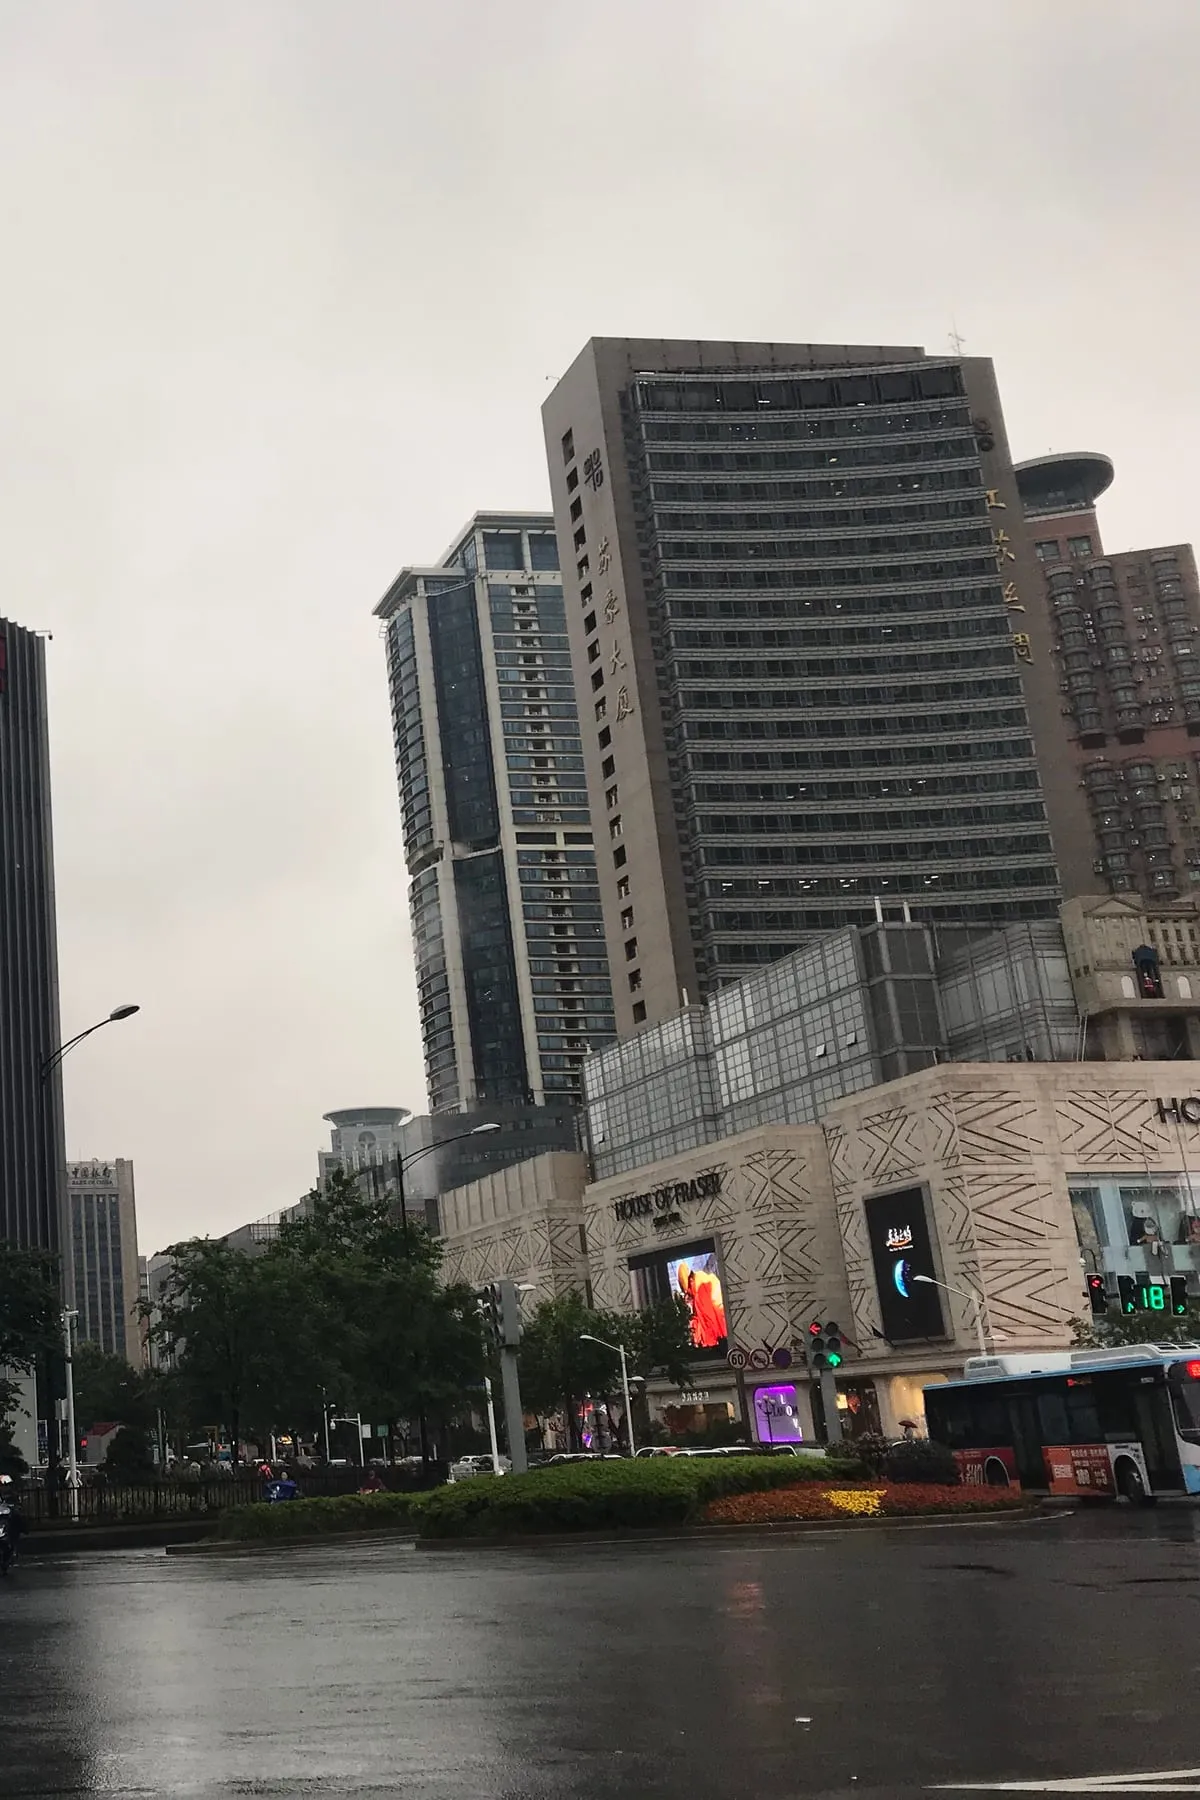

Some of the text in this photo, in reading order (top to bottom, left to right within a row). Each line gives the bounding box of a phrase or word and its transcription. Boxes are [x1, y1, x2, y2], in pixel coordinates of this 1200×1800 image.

[614, 1193, 653, 1221] HOUSE
[654, 1187, 674, 1210] OF
[674, 1174, 722, 1205] FRASER
[1142, 1286, 1165, 1310] 18
[731, 1354, 743, 1365] 60
